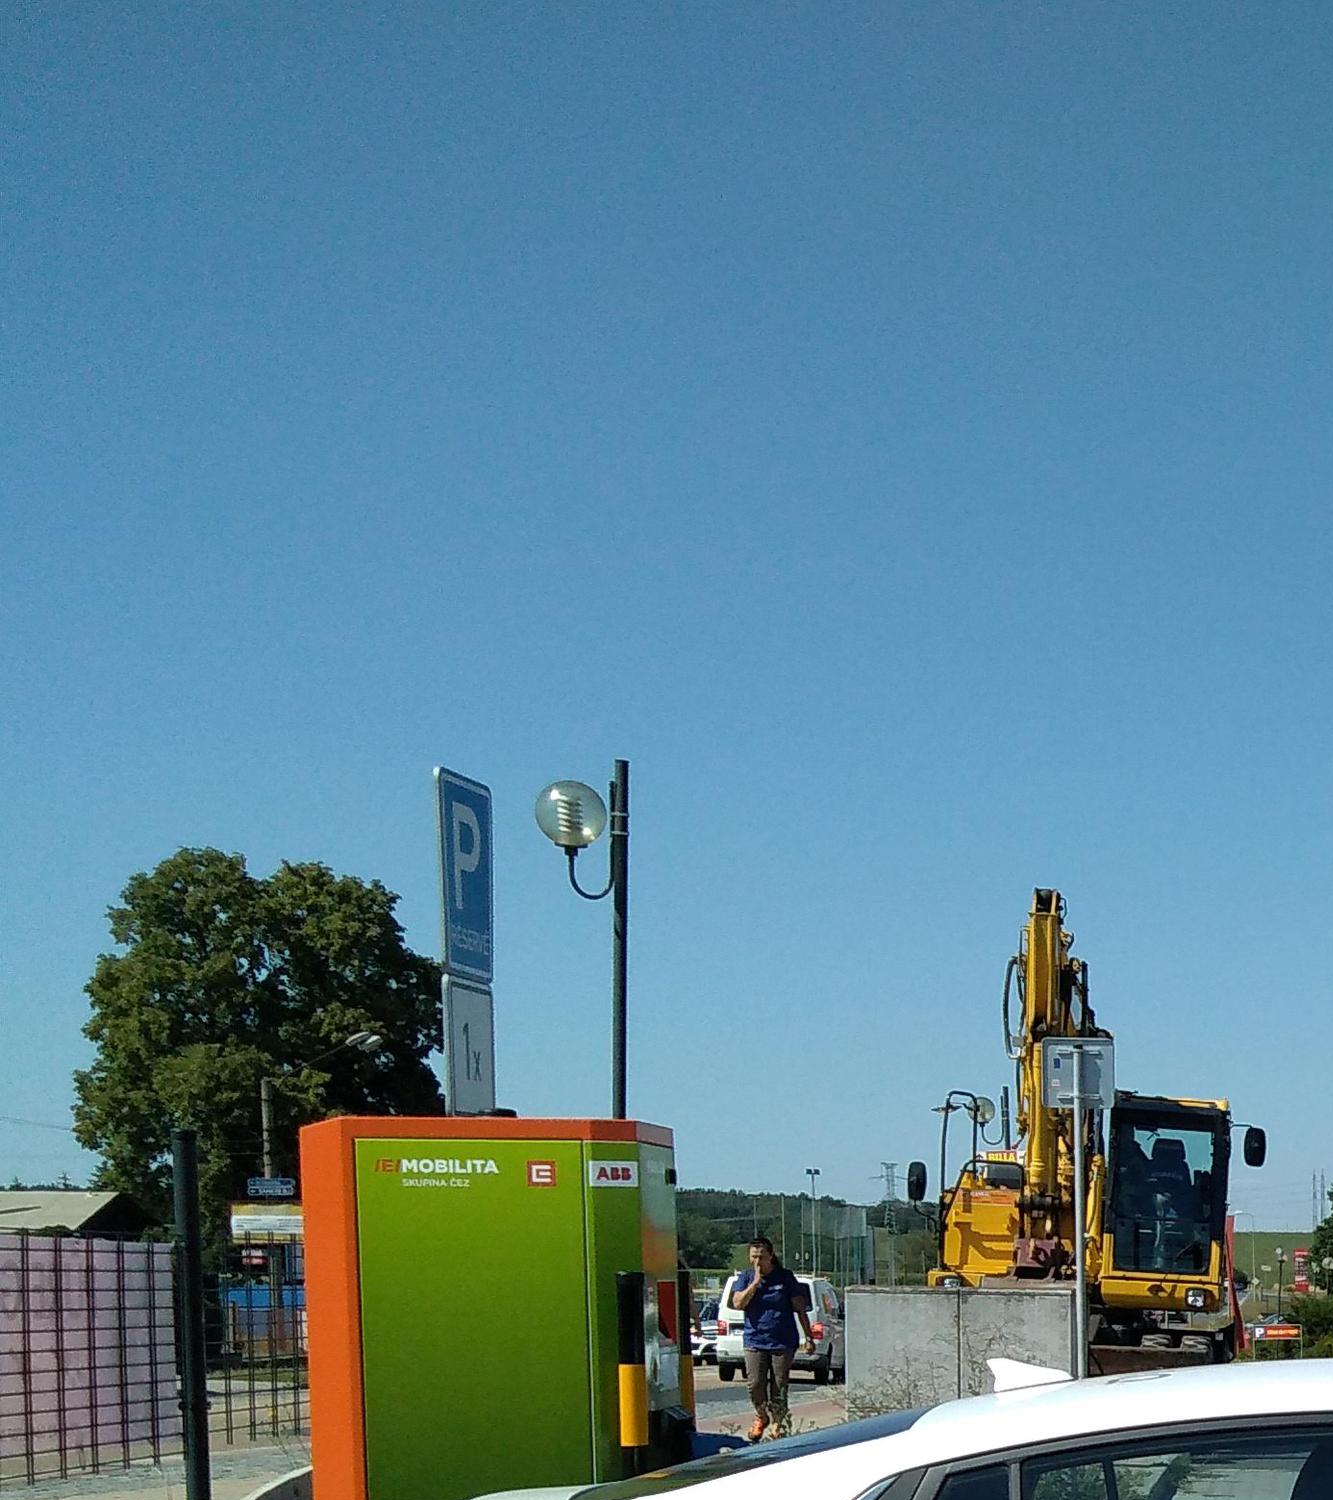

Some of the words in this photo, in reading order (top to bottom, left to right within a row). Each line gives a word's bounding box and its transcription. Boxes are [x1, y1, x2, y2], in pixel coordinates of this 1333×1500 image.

[452, 801, 481, 910] P
[596, 1166, 632, 1181] ABB
[402, 1178, 448, 1188] SKUPINA
